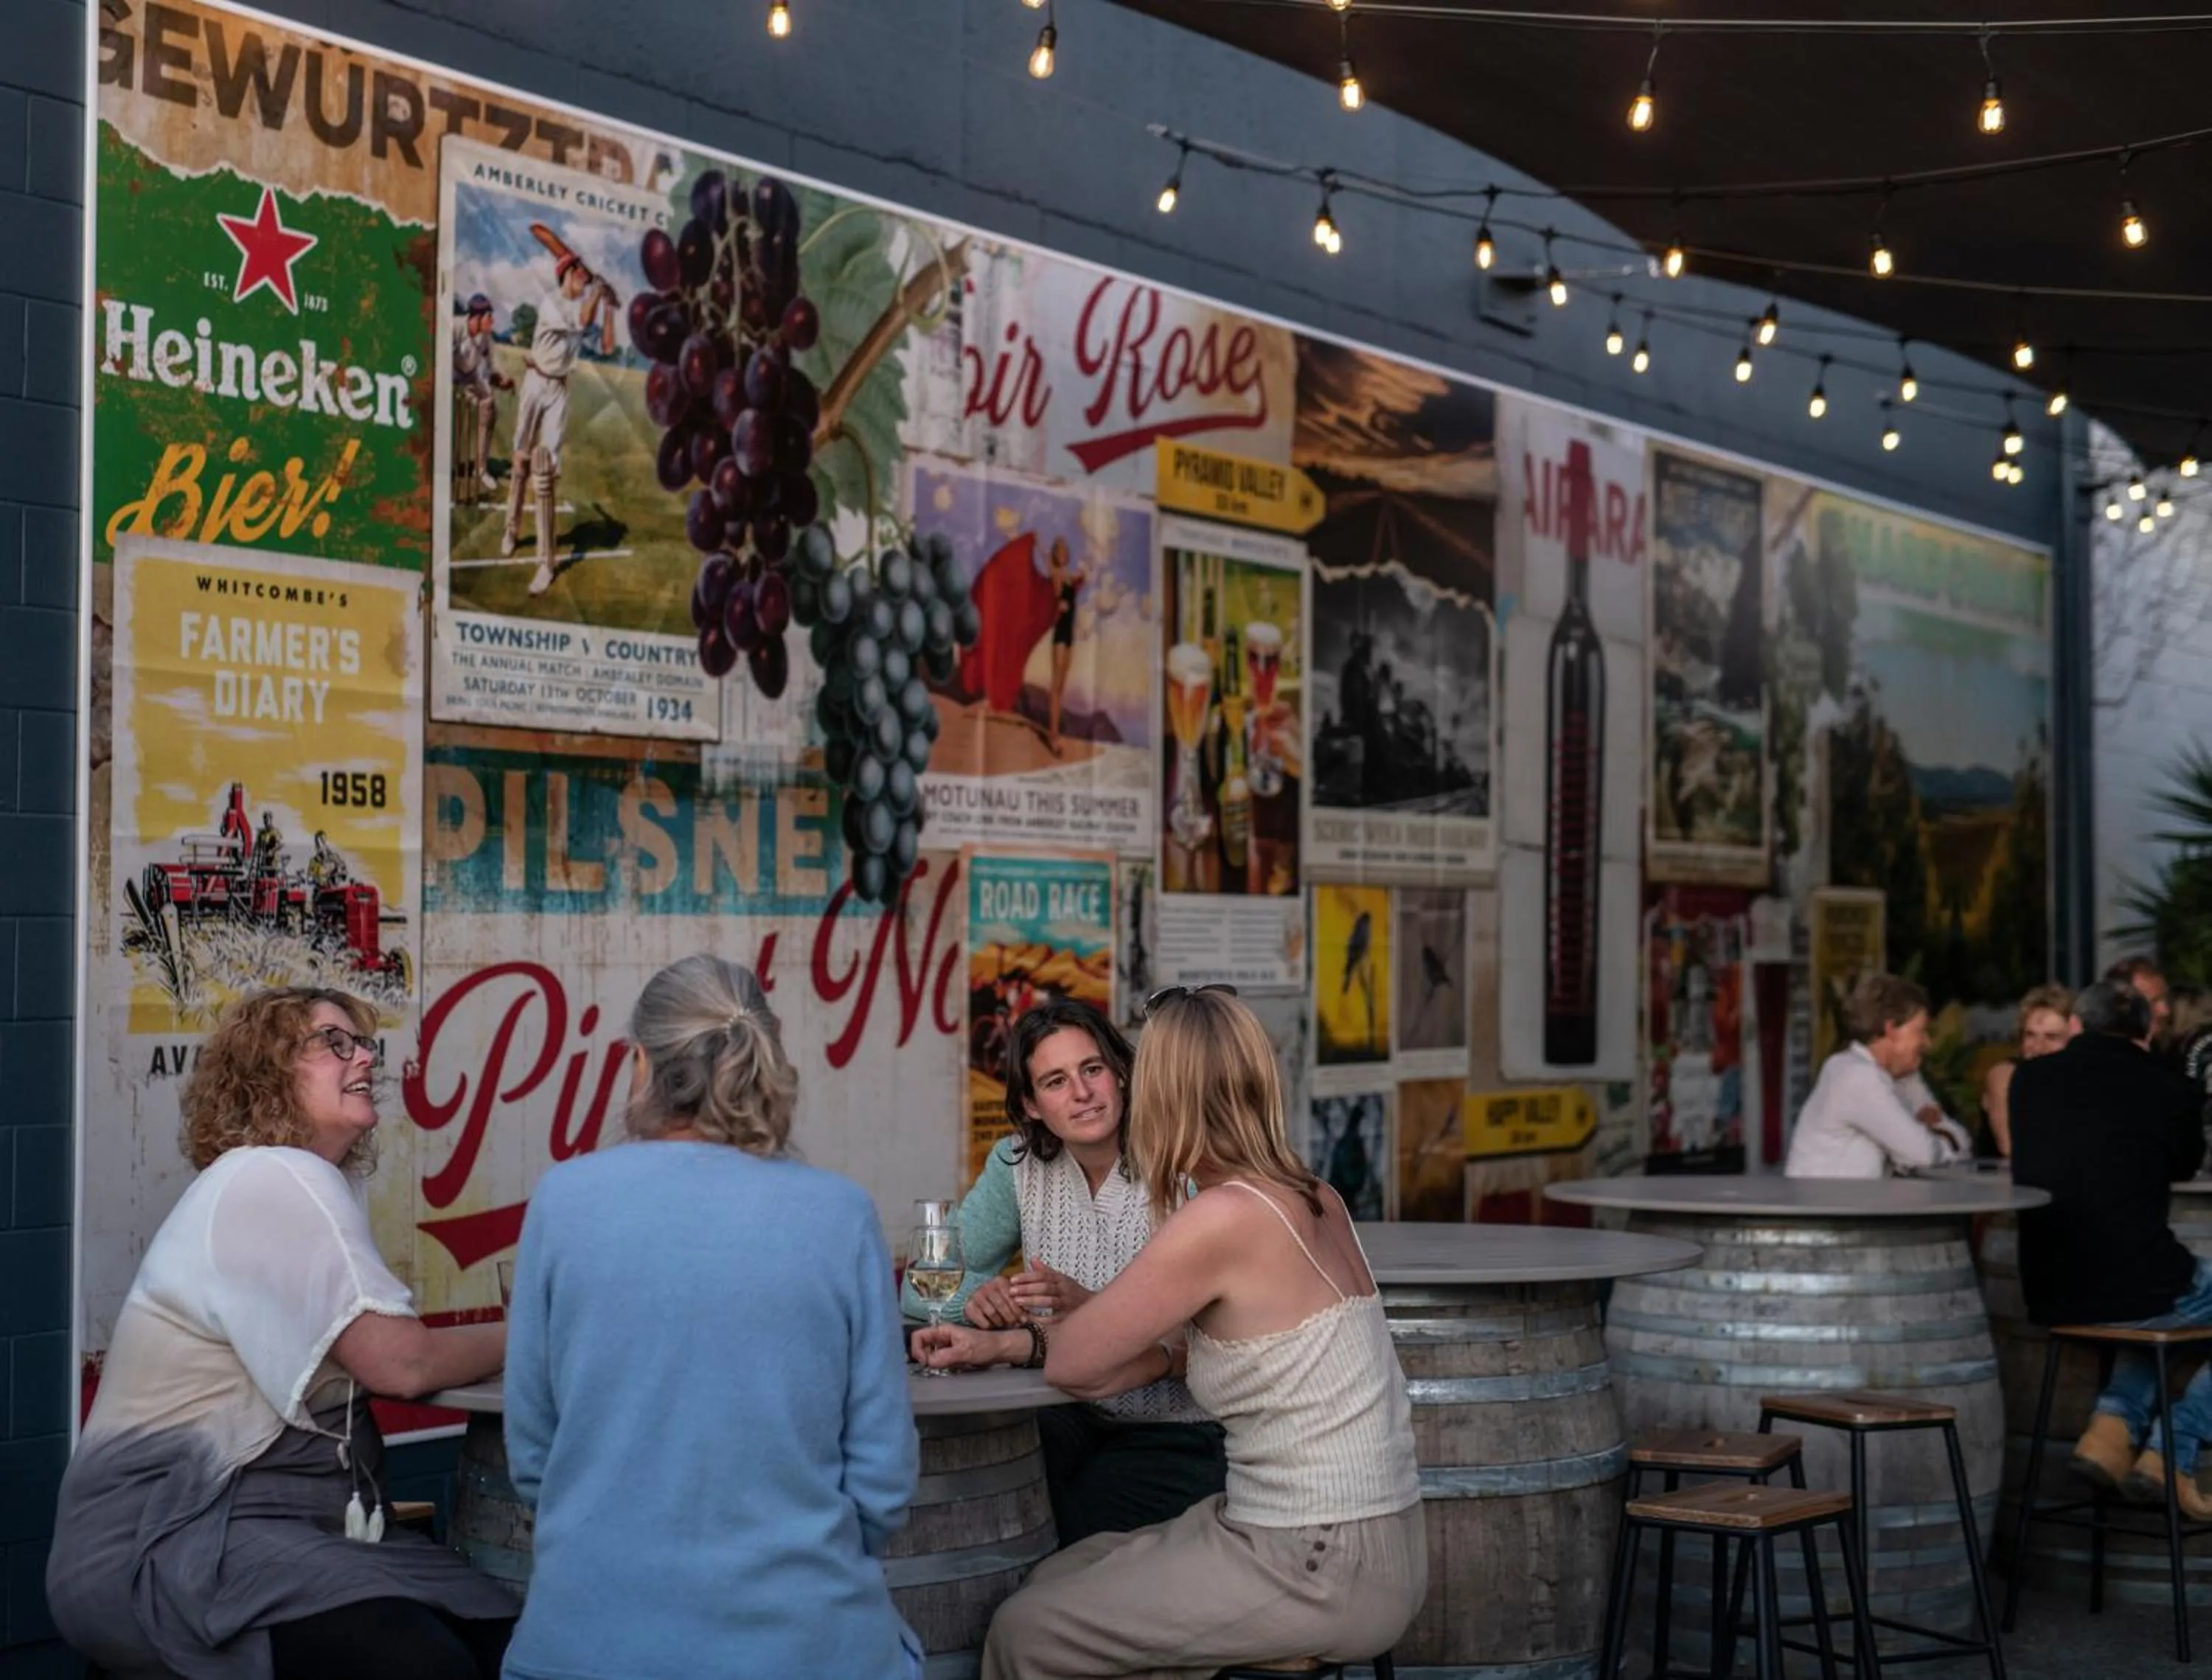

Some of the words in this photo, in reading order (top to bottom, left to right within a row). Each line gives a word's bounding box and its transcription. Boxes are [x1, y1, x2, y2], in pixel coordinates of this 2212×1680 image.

[474, 163, 568, 200] AMBERLEY
[575, 190, 649, 221] CRICKET
[1075, 276, 1267, 431] Rose
[105, 437, 361, 548] Bier!
[197, 575, 348, 607] WHITCOMBE'S
[180, 611, 360, 675] FARMER'S
[452, 652, 476, 667] THE
[480, 653, 532, 673] ANNUAL
[538, 661, 581, 678] MATCH
[455, 620, 571, 652] TOWNSHIP
[605, 639, 697, 666] COUNTRY
[214, 670, 330, 724] DIARY
[463, 676, 535, 697] SATURDAY
[575, 687, 637, 706] OCTOBER
[647, 697, 693, 723] 1934
[320, 771, 386, 808] 1958
[922, 782, 1020, 811] MOTUNAU
[1025, 790, 1065, 814] THIS
[979, 879, 1040, 920] ROAD
[1048, 881, 1102, 922] RACE
